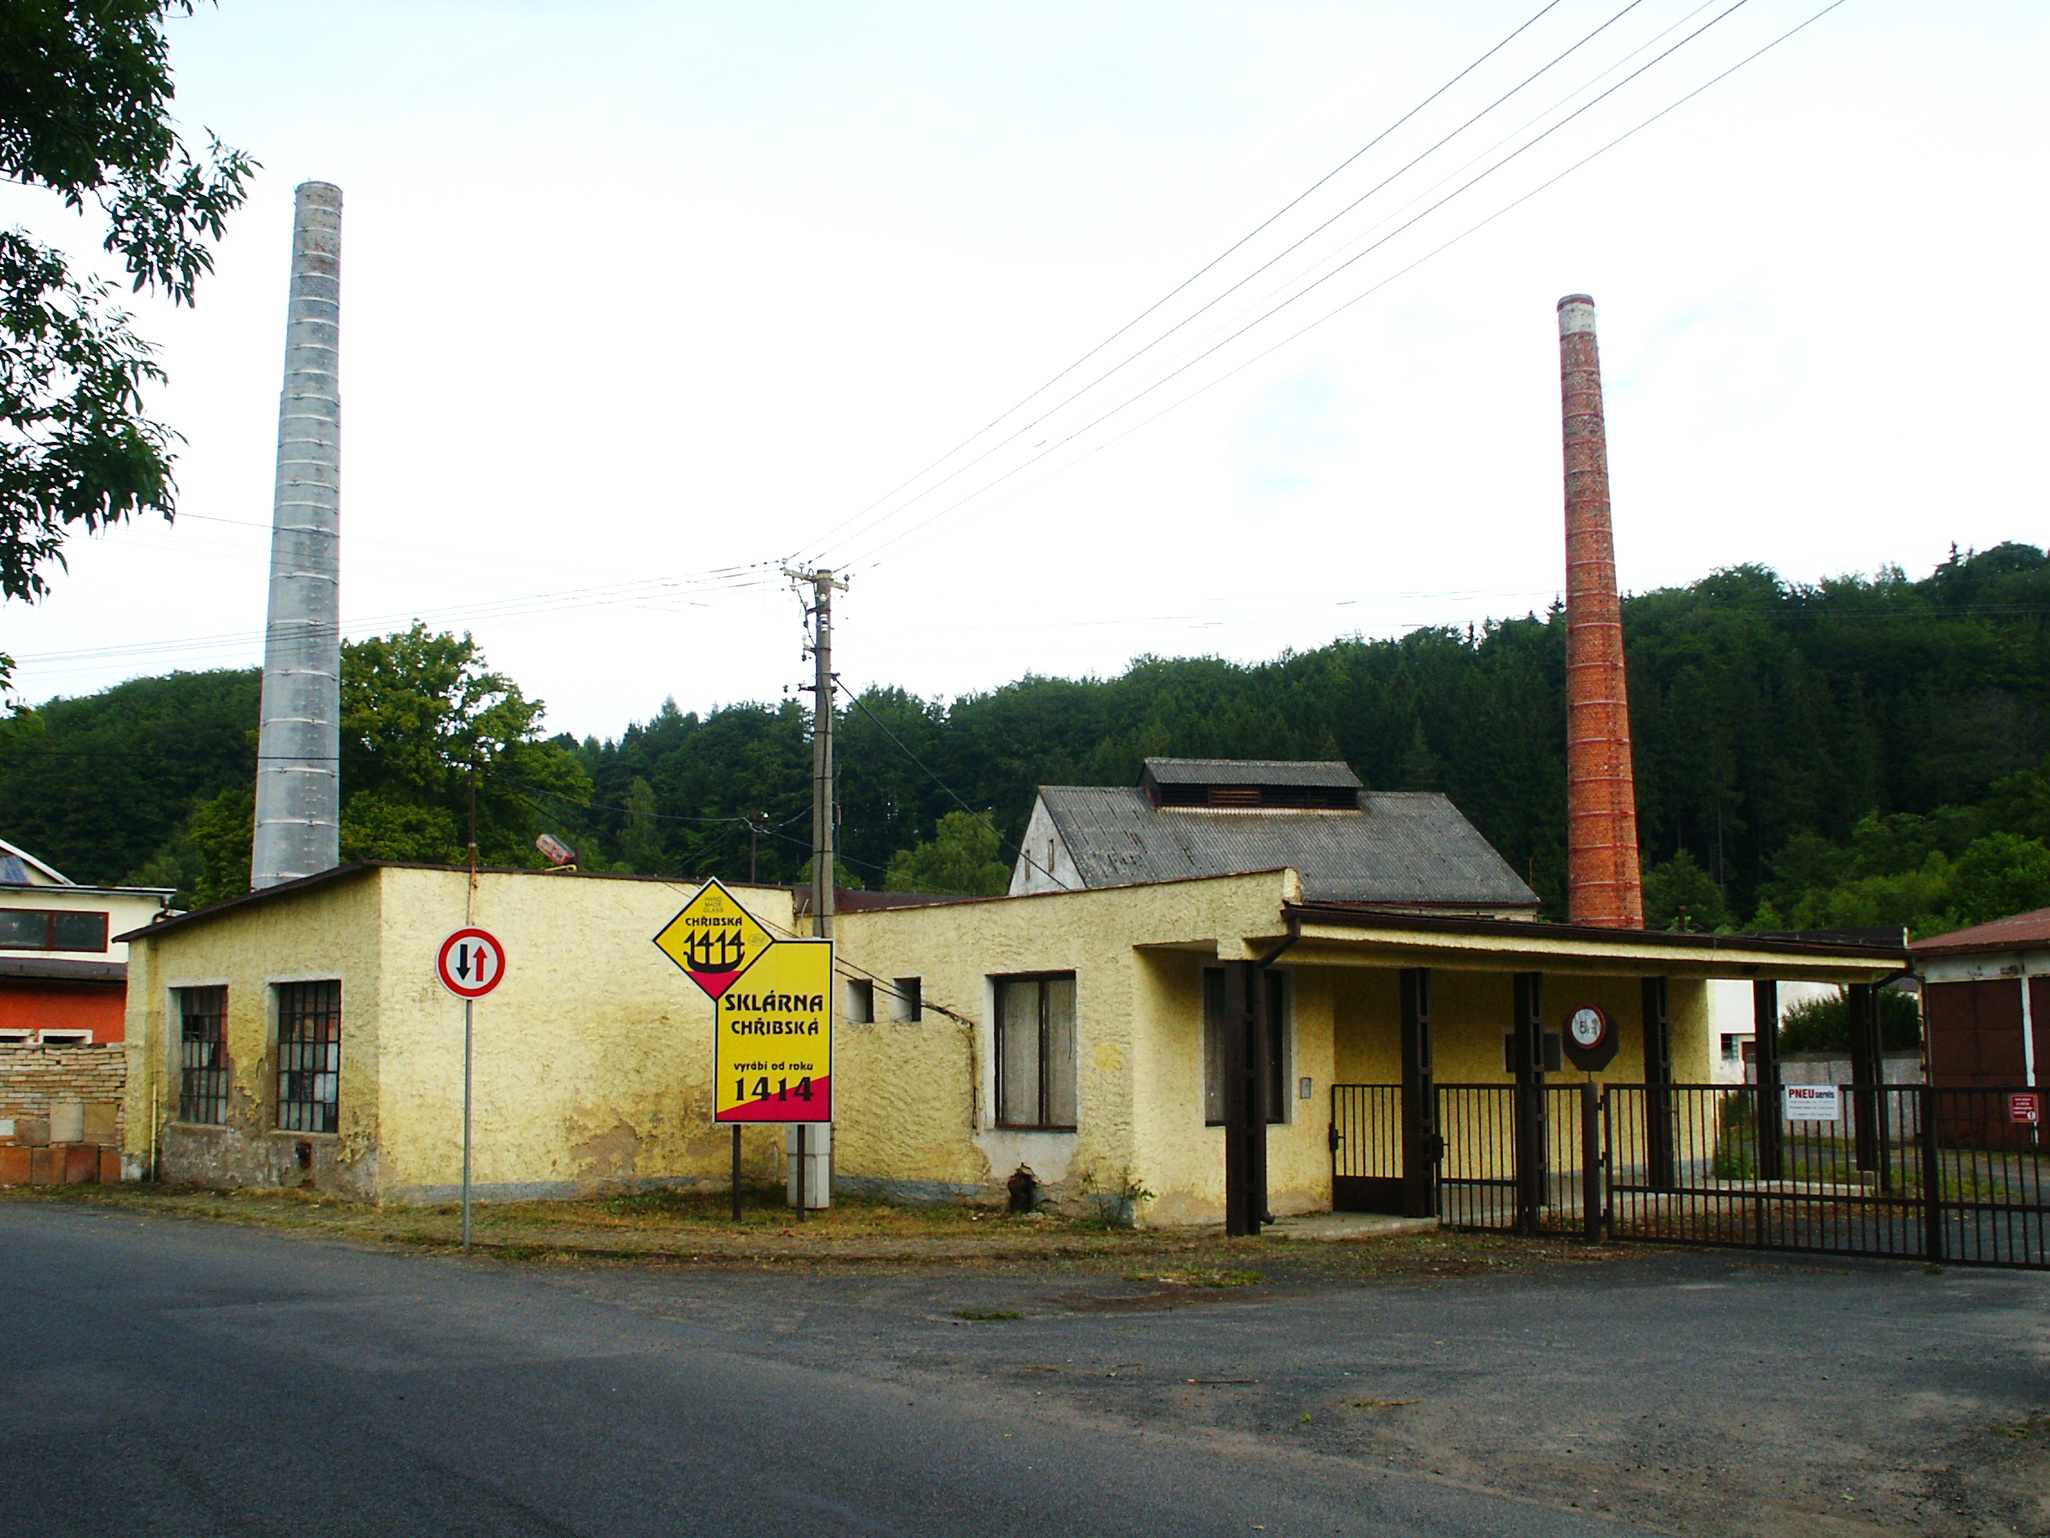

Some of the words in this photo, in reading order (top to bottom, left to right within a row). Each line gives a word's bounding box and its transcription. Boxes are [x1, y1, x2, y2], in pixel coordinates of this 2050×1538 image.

[685, 915, 743, 927] CHŘIBSKÁ
[683, 929, 745, 964] 1414
[725, 990, 823, 1013] SKLÁRNA
[731, 1017, 818, 1035] CHŘIBSKÁ
[772, 1062, 785, 1070] od
[789, 1062, 813, 1070] roku
[735, 1076, 814, 1101] 1414
[1789, 1089, 1814, 1098] PNEU
